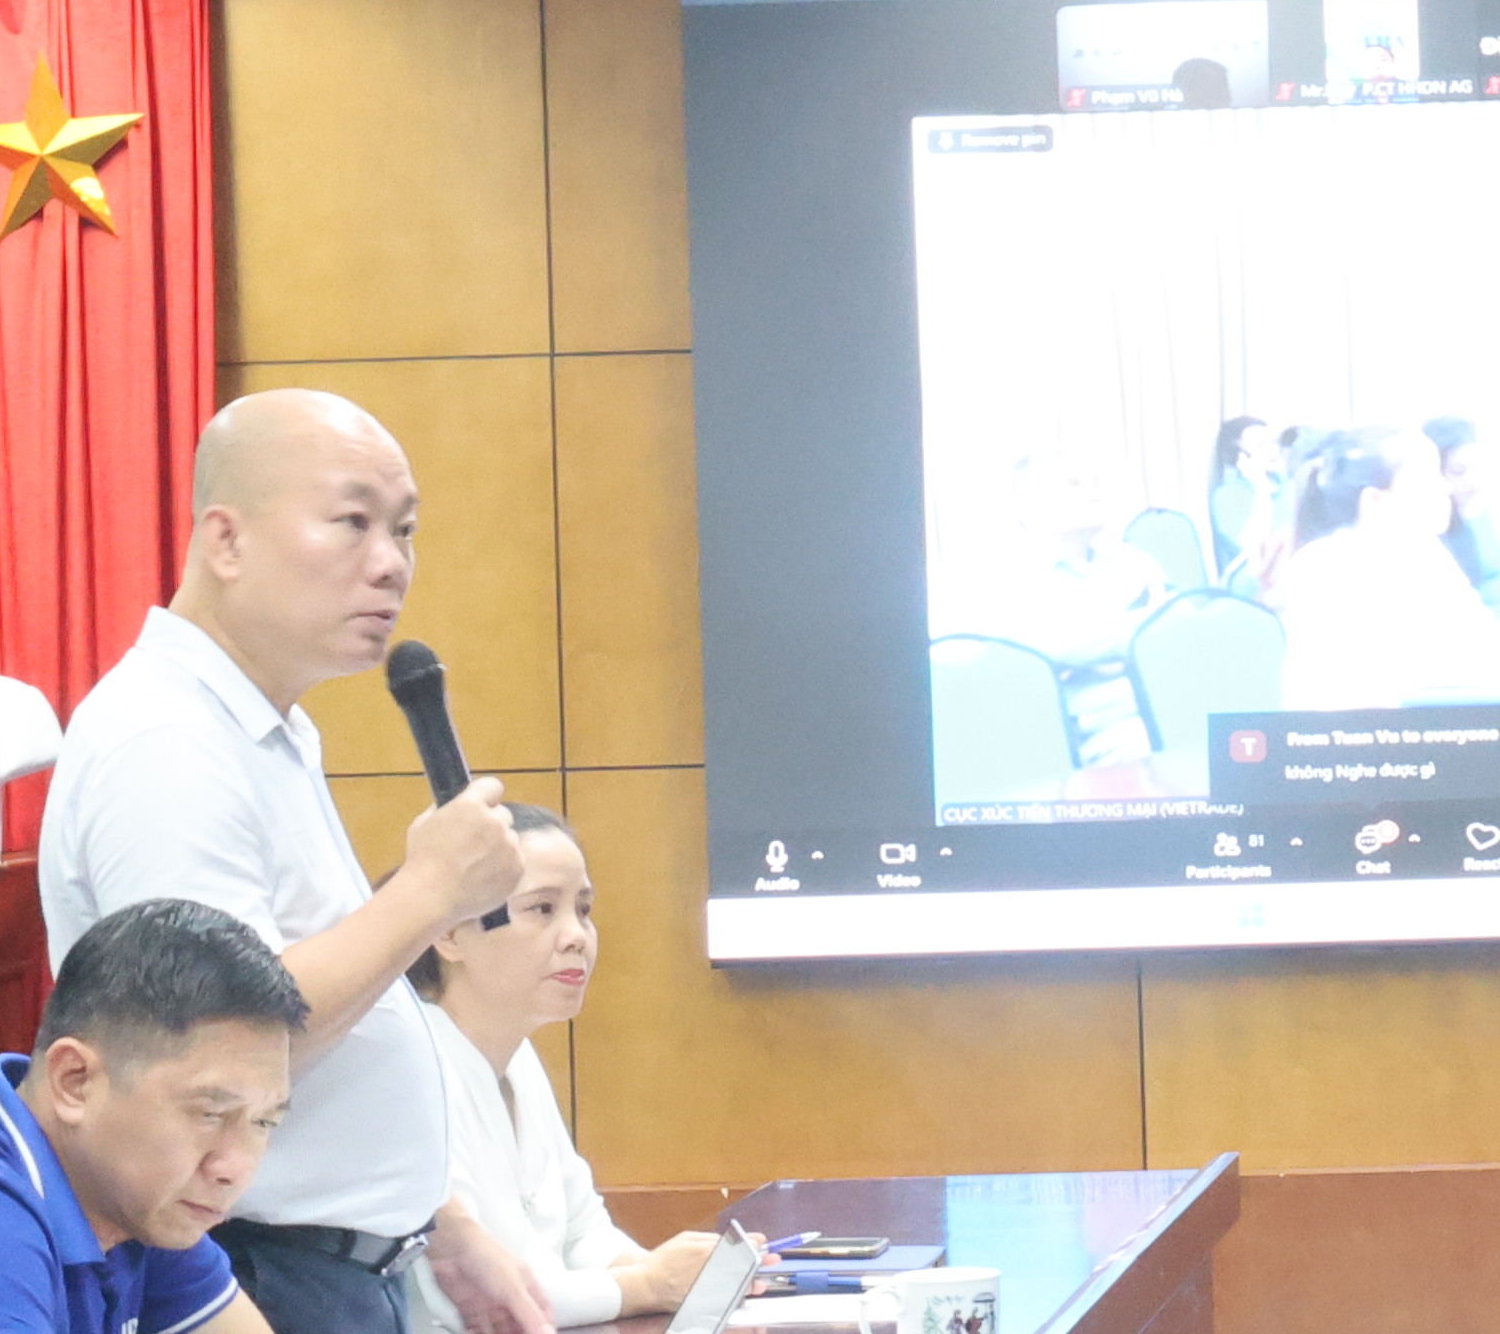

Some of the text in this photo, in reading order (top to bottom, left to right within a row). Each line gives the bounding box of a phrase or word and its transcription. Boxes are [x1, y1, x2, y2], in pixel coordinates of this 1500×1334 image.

[1286, 731, 1330, 747] From
[1401, 728, 1421, 745] to
[1422, 727, 1500, 746] everyone
[1241, 738, 1257, 755] T
[1335, 763, 1377, 783] Nghe
[1186, 863, 1272, 881] Participants
[1355, 859, 1391, 875] Chat
[755, 877, 800, 891] Audio
[877, 873, 921, 888] Video
